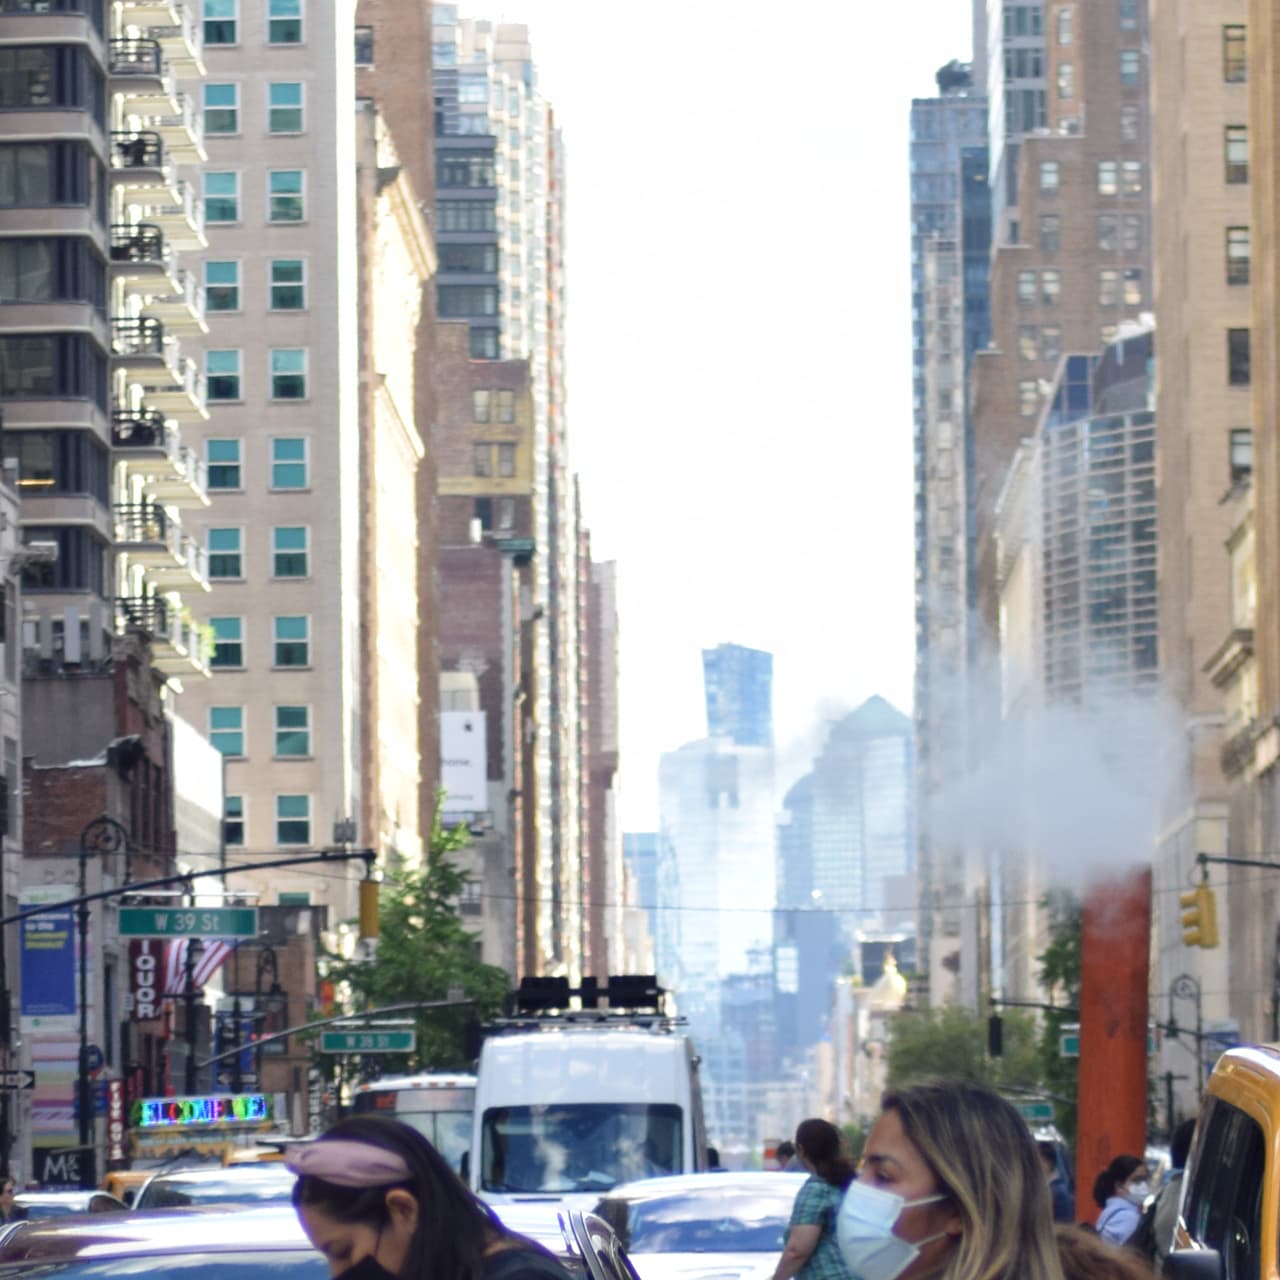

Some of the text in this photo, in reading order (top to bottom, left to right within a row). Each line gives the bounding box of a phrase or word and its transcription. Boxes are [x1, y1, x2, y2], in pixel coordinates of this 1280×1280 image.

[154, 913, 219, 931] W 39 St
[136, 940, 156, 1019] IQUOR
